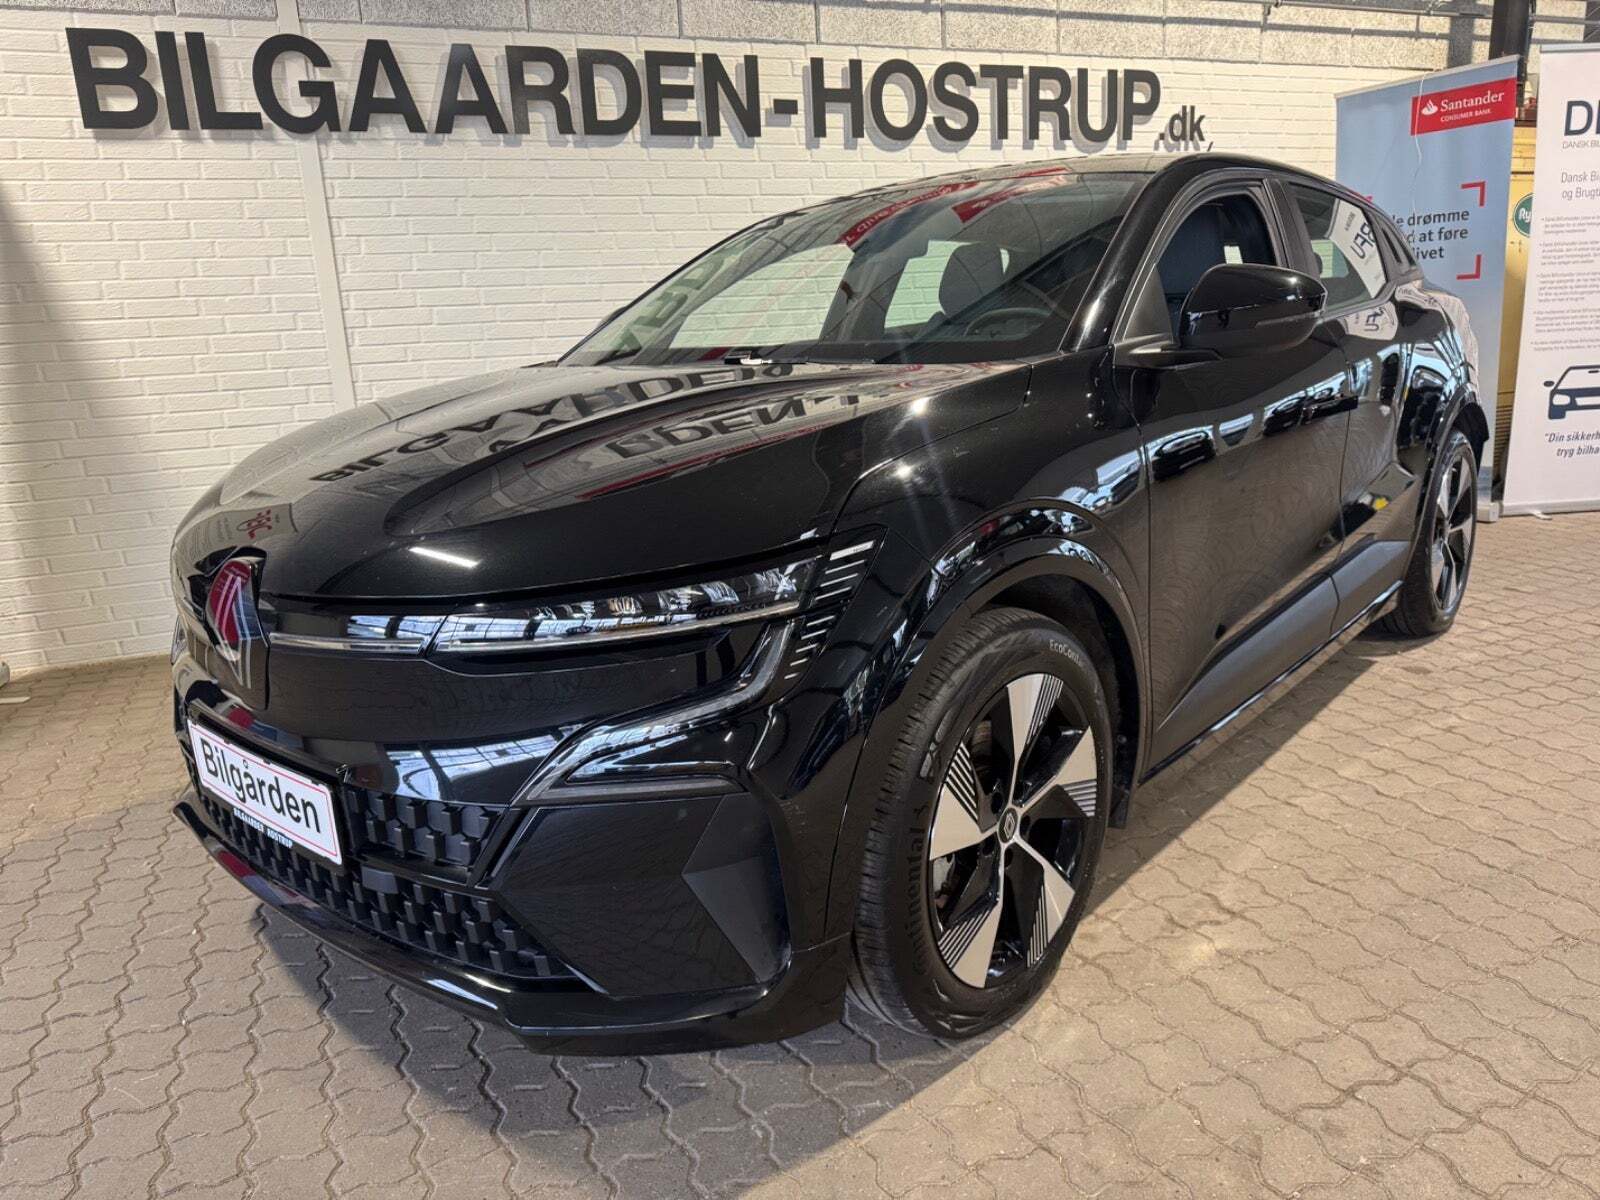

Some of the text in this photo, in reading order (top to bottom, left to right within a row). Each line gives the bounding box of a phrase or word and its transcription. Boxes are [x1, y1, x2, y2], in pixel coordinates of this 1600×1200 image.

[1440, 90, 1505, 112] Santander
[1440, 108, 1492, 122] CONSUMER BANK
[1564, 99, 1600, 136] D
[1562, 140, 1590, 149] DANSK
[1561, 171, 1589, 183] Dansk
[1562, 190, 1573, 200] og
[1407, 209, 1470, 226] drømme
[1519, 207, 1532, 223] Ry
[1418, 230, 1434, 243] at
[1437, 226, 1469, 241] føre
[1556, 448, 1575, 458] tryg
[200, 738, 321, 834] Bilgården
